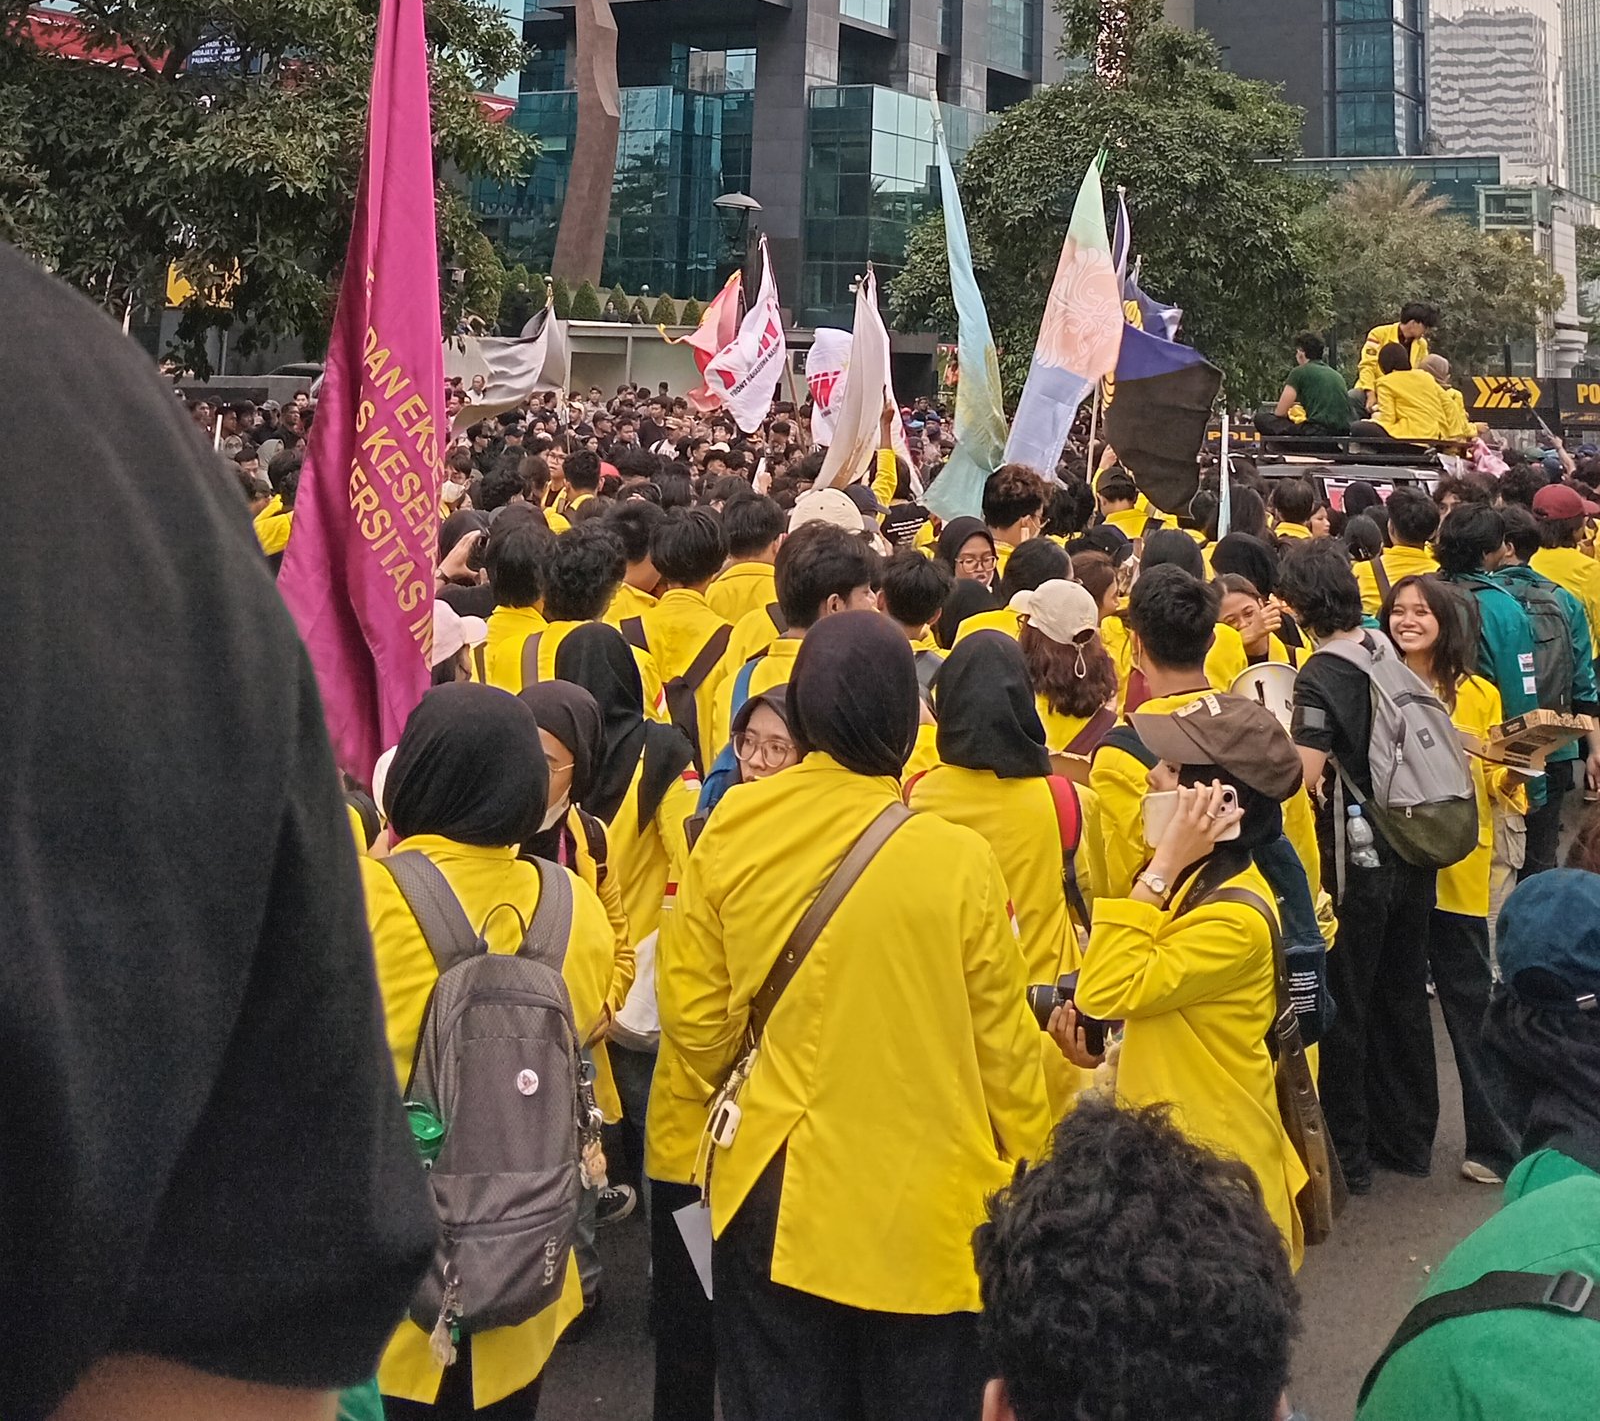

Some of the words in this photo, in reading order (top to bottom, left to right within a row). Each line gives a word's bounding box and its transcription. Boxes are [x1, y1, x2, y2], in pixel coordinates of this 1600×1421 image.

[364, 326, 411, 400] DAN
[729, 379, 748, 398] FRONT
[350, 457, 427, 612] ERSITAS
[542, 1236, 557, 1286] torch
